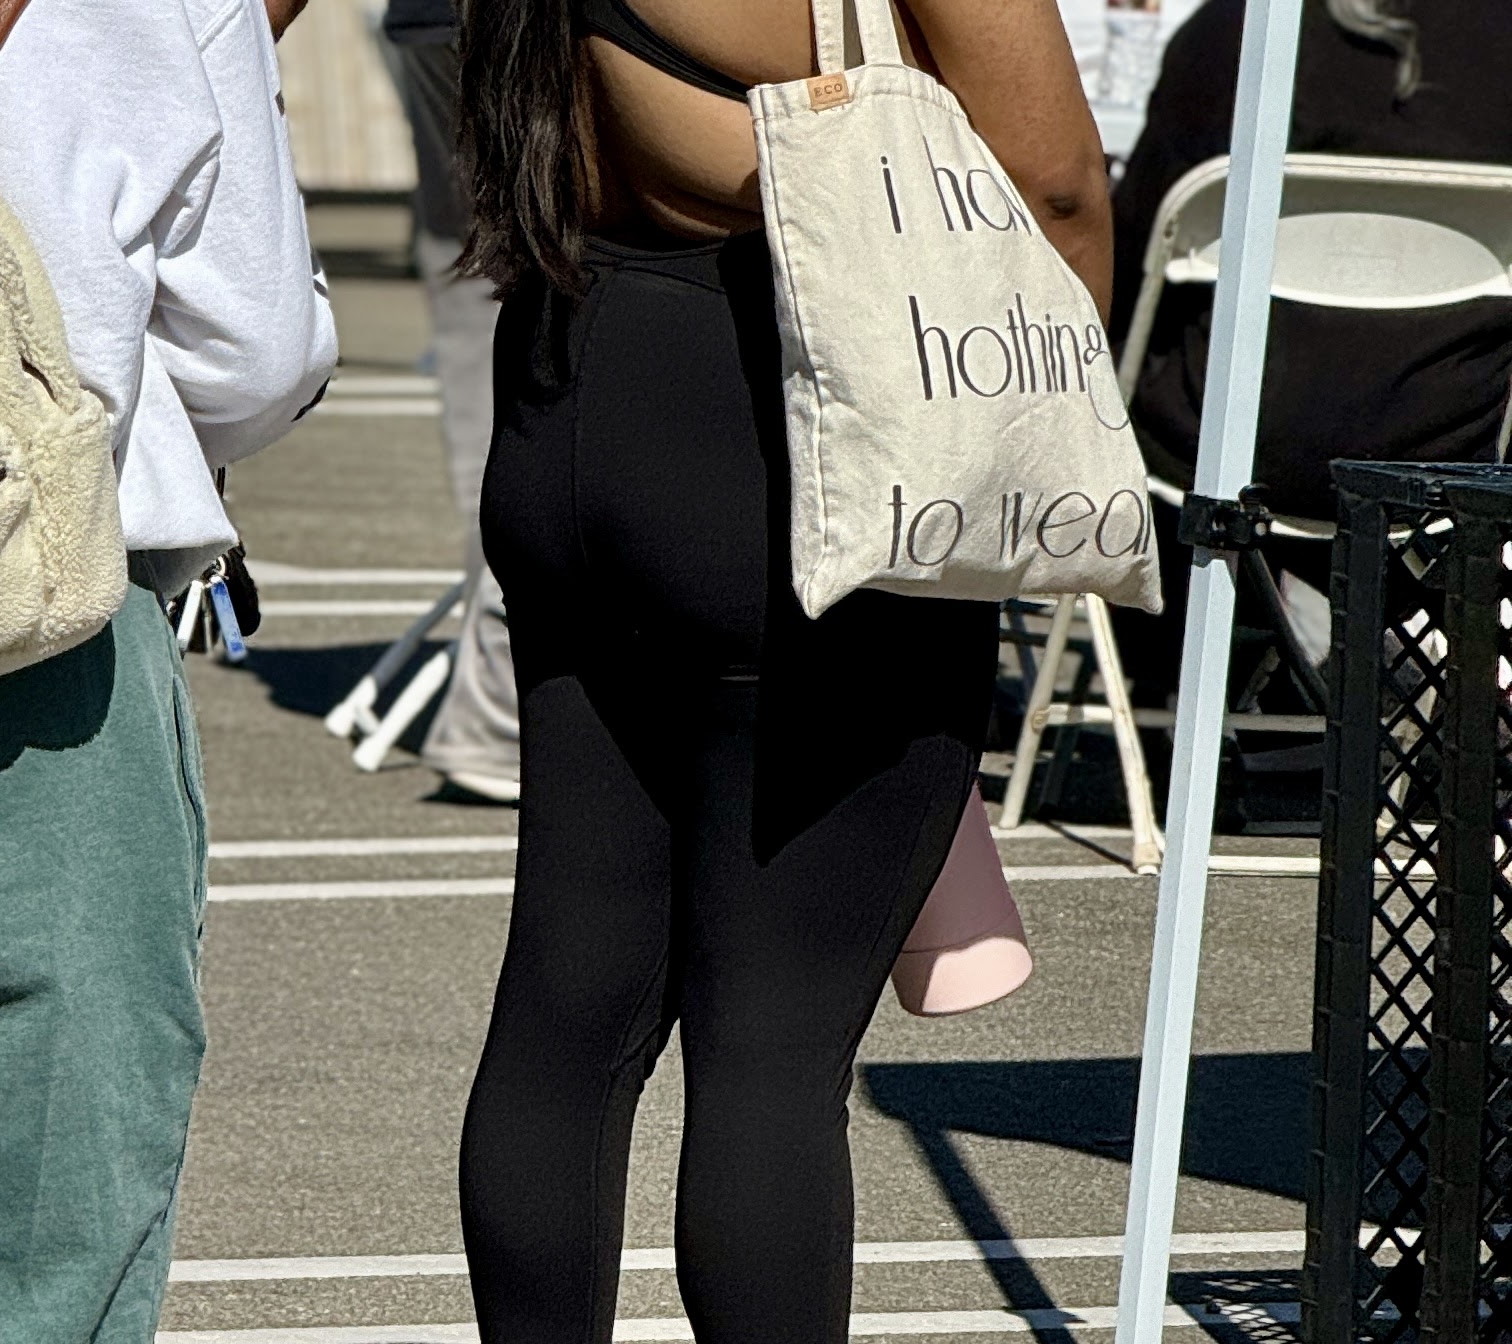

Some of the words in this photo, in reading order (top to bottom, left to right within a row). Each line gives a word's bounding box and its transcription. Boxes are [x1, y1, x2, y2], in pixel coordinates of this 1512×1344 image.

[813, 82, 843, 97] ECO
[879, 155, 902, 234] i
[922, 134, 1033, 237] hav
[887, 484, 964, 569] to
